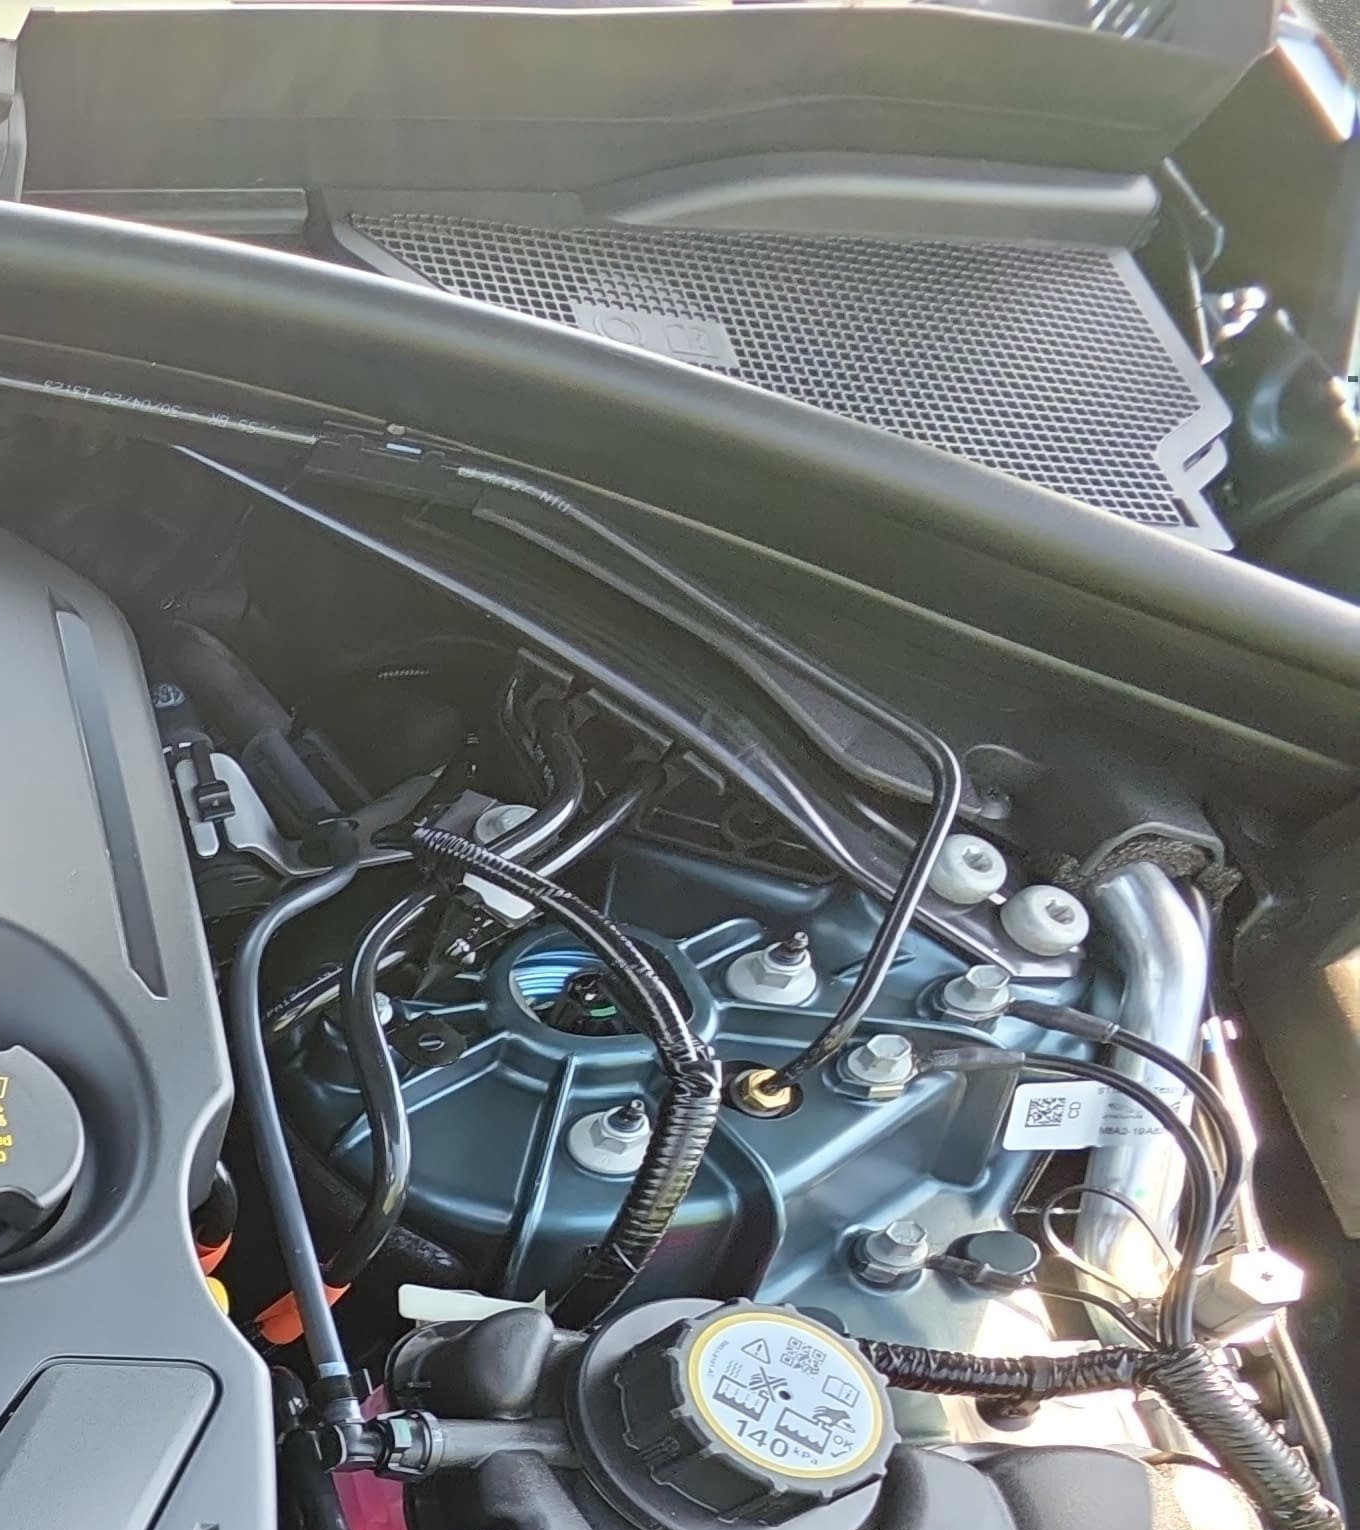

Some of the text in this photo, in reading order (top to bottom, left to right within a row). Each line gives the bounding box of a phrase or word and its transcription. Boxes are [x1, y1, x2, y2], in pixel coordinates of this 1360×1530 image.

[735, 1419, 819, 1465] 140 kPa
[832, 1435, 856, 1452] OK
